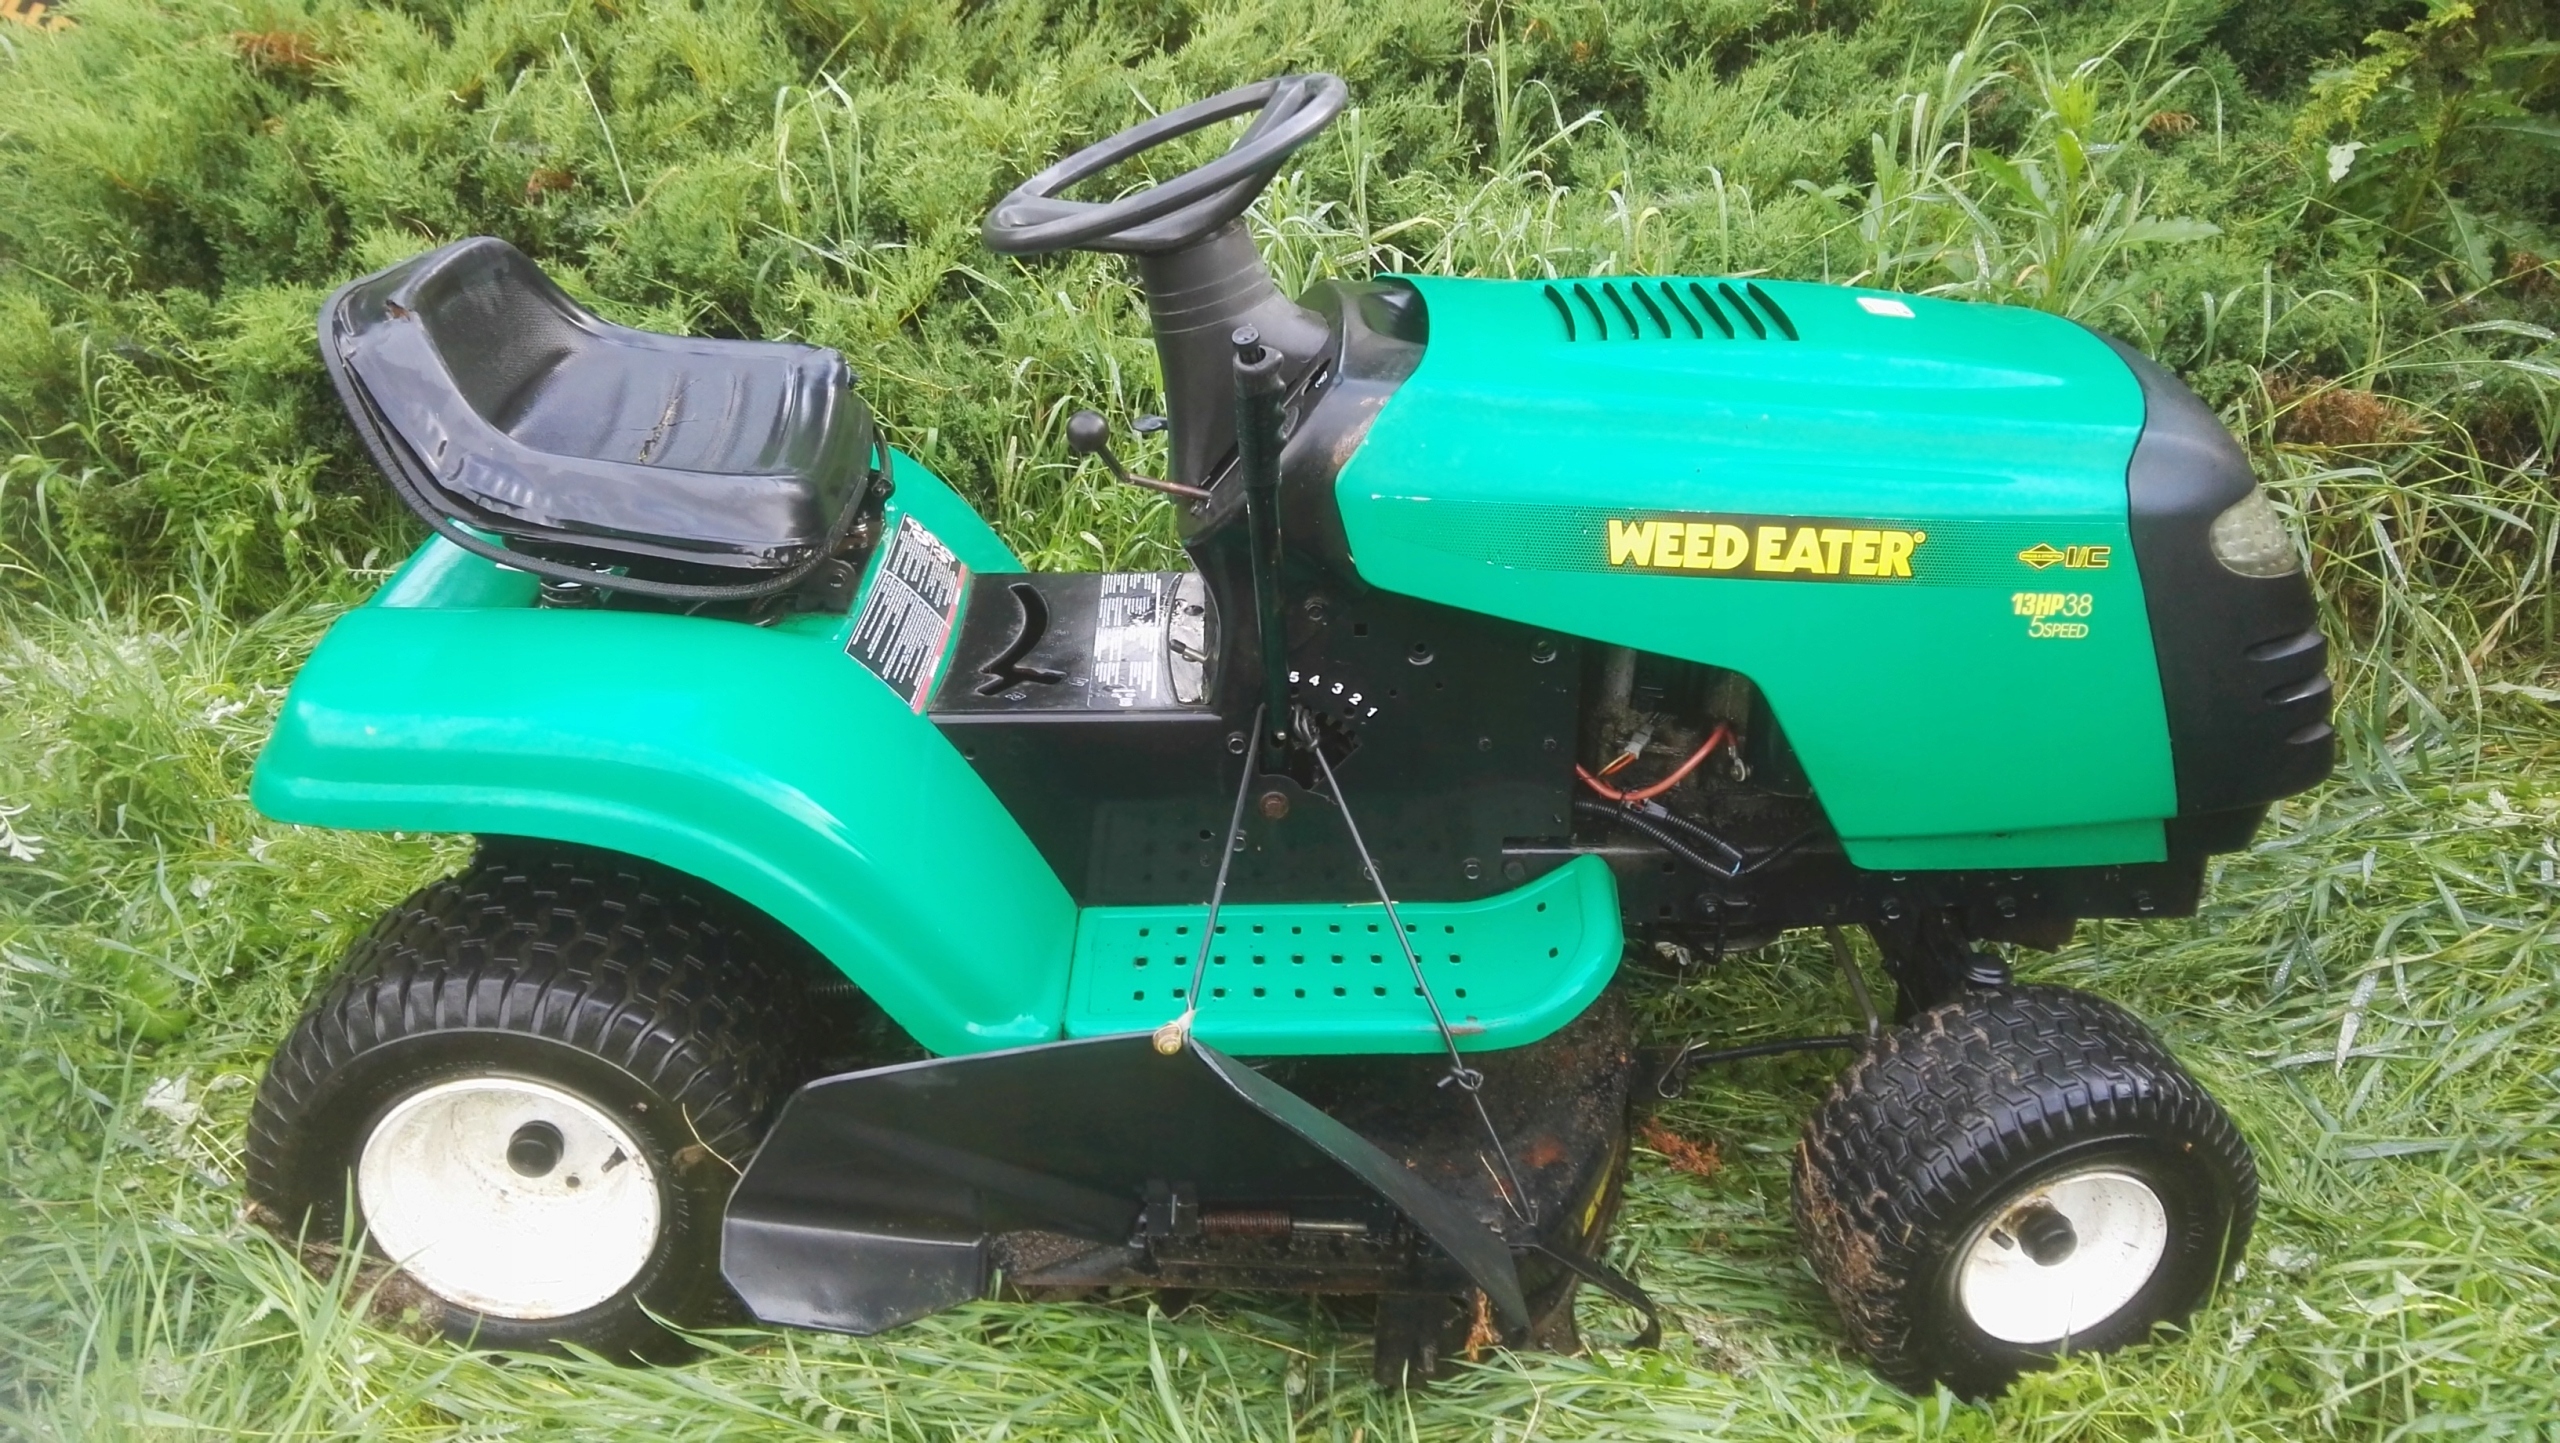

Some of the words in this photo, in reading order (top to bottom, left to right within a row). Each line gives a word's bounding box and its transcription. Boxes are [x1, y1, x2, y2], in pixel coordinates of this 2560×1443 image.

[1607, 519, 1750, 570] WEED
[1289, 671, 1300, 683] 5
[1308, 674, 1320, 687] 4
[1331, 682, 1344, 695] 3
[1348, 692, 1362, 706] 2
[1366, 706, 1378, 718] 1
